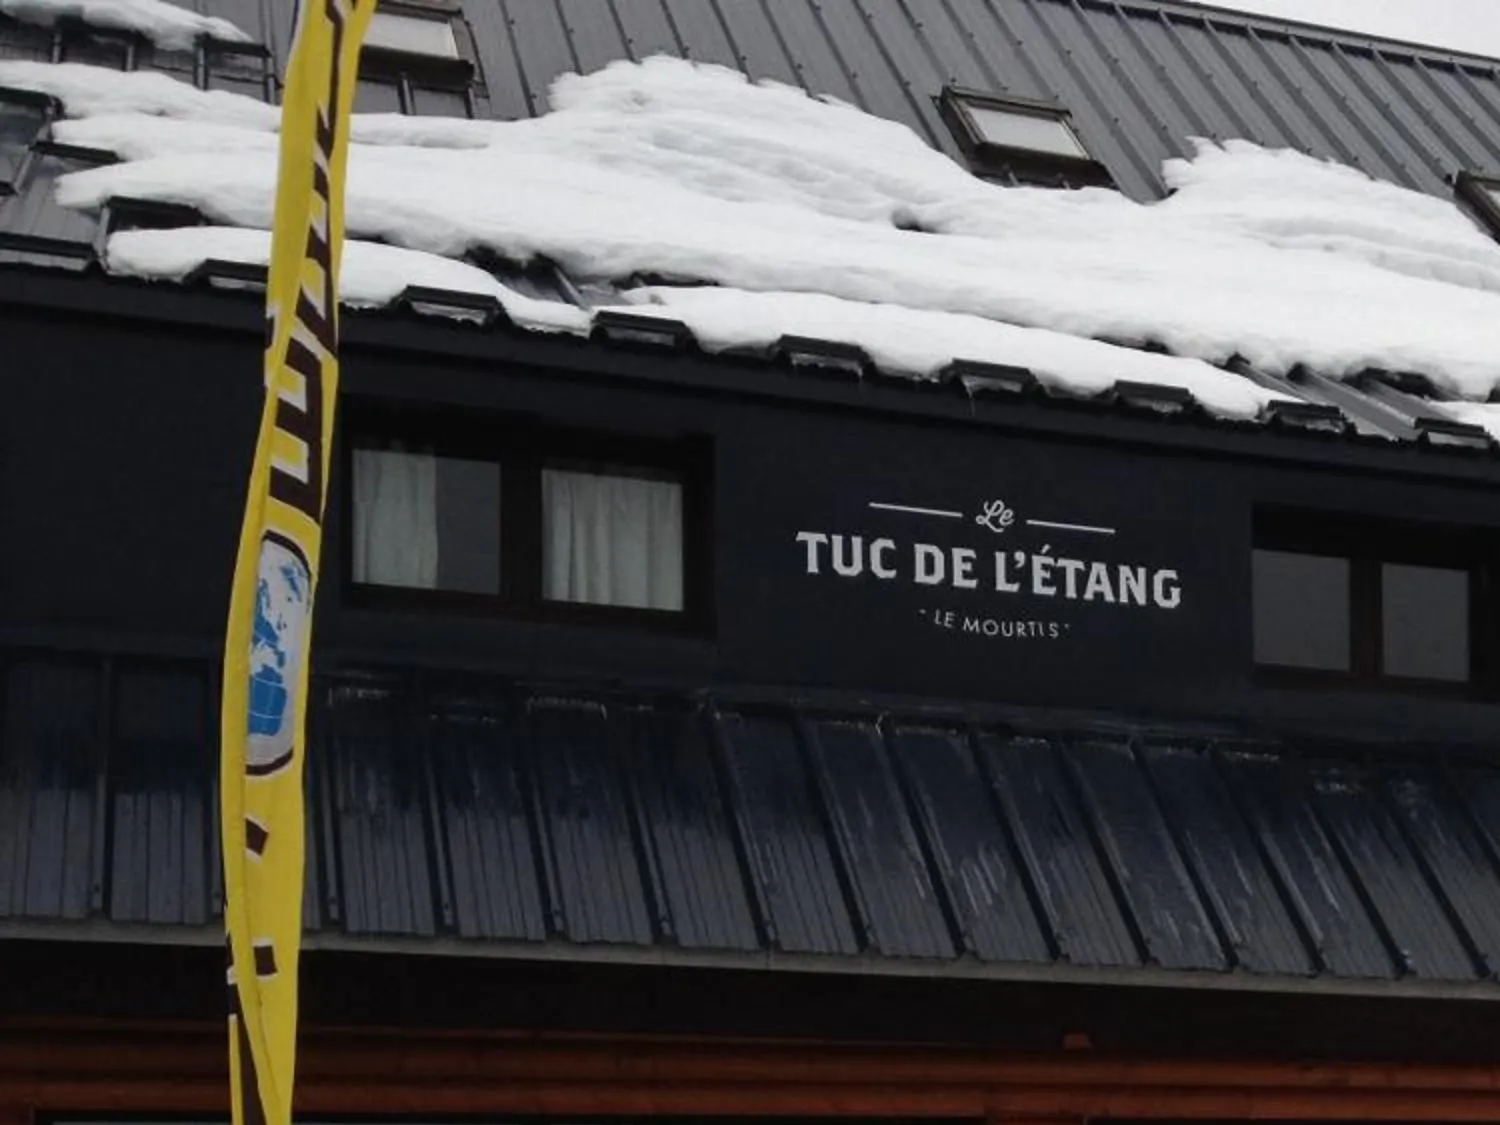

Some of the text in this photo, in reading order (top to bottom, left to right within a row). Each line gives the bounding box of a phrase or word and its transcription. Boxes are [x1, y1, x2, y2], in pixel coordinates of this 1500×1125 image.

[974, 498, 1015, 534] Le
[795, 530, 1182, 609] TUC DE L'ÉTANG
[932, 608, 1061, 639] LE MOURTIS
